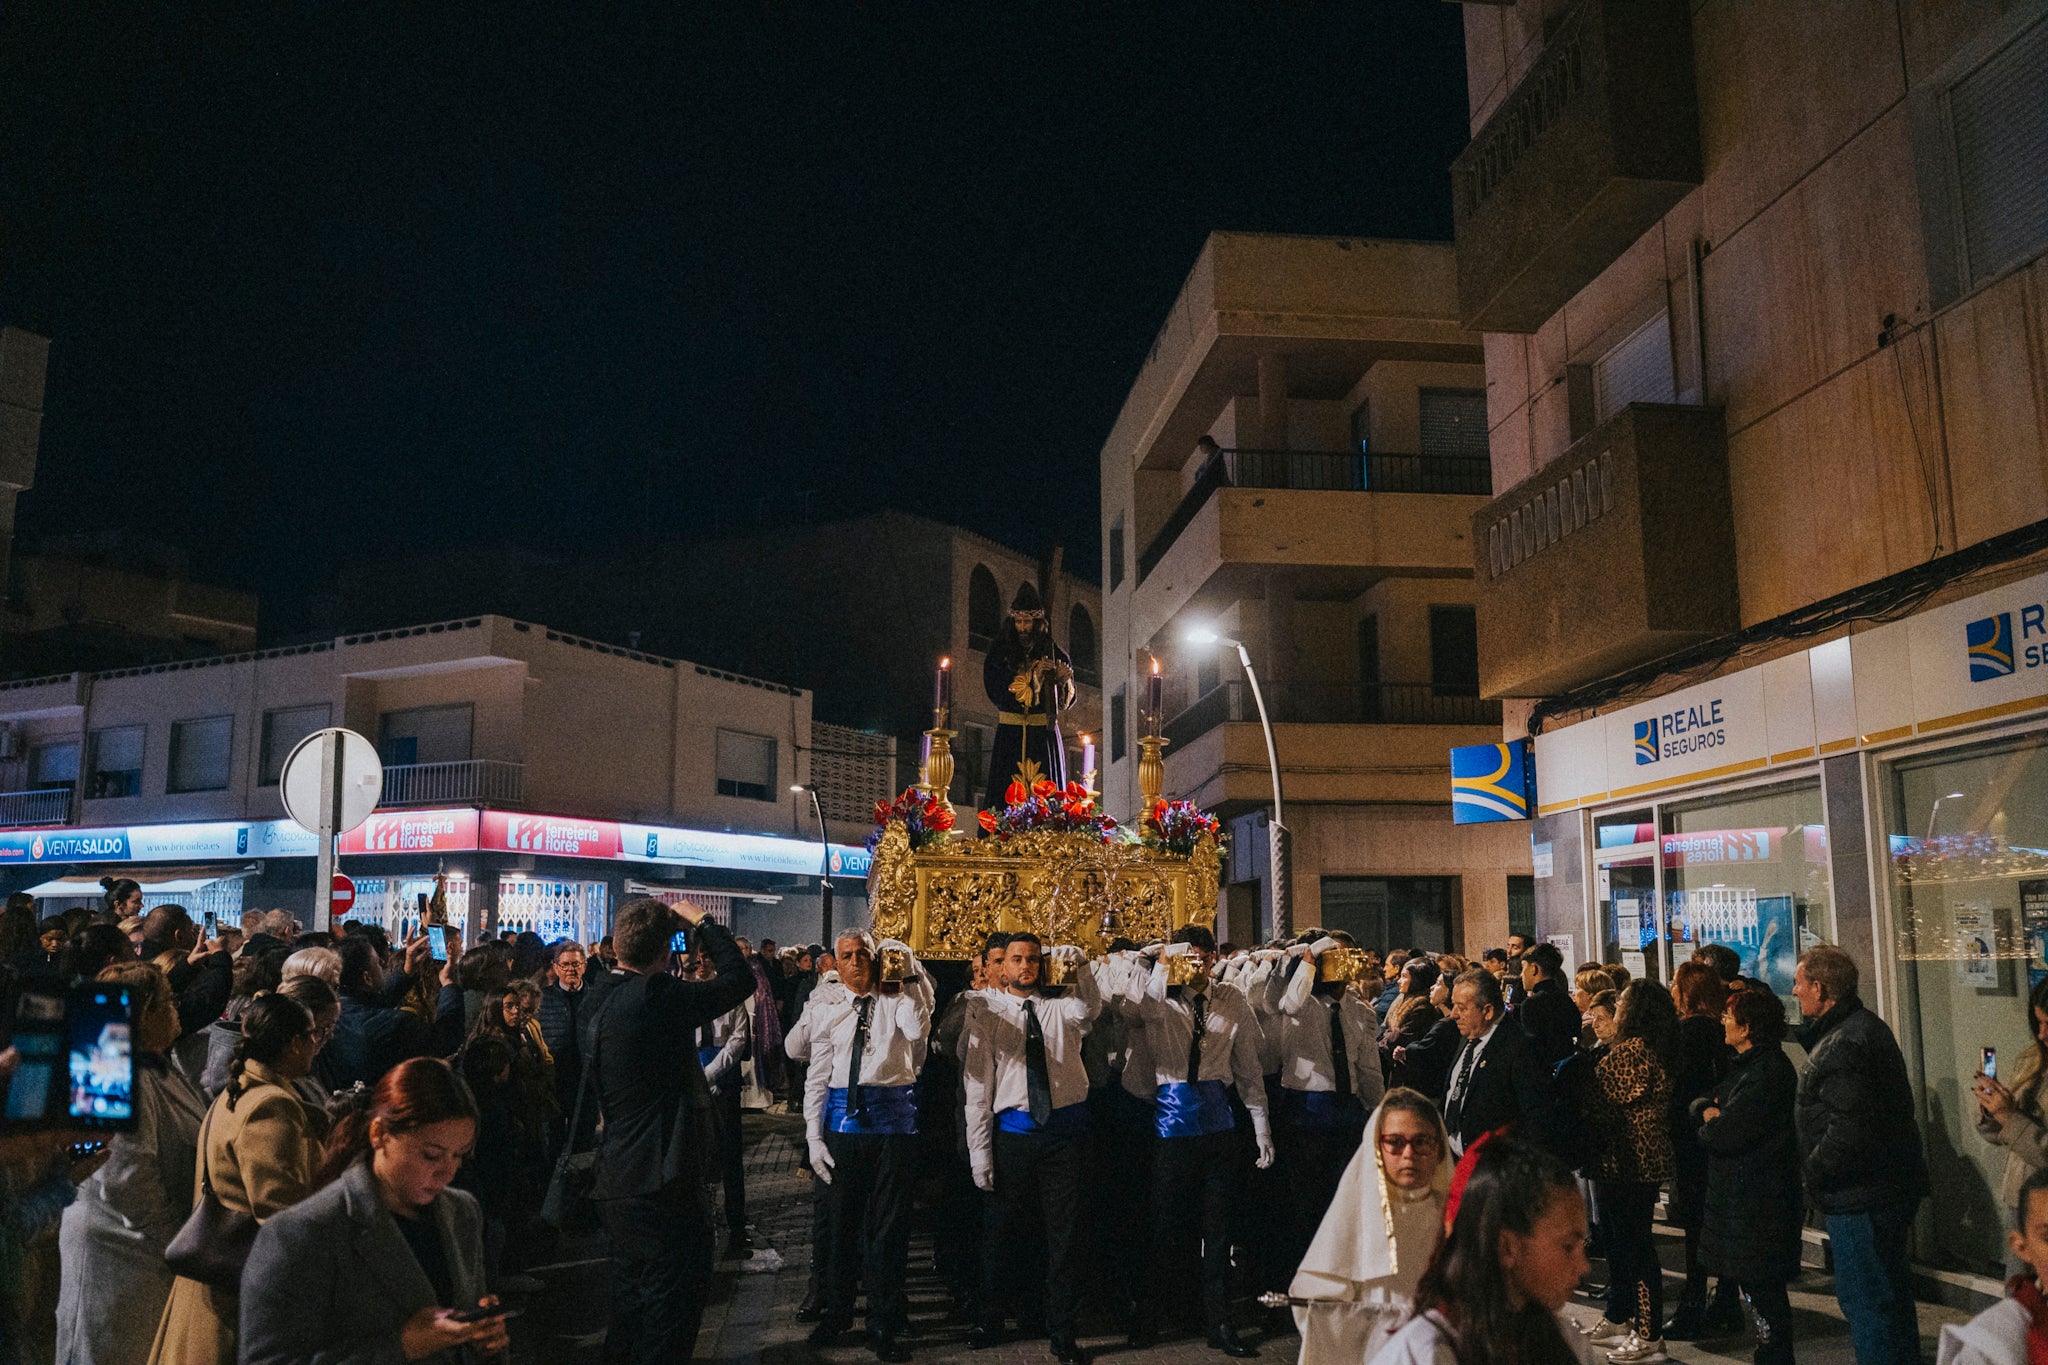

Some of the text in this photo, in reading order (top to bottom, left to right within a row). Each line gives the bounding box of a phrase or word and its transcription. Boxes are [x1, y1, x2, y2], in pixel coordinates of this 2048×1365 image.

[2021, 601, 2048, 640] R
[1661, 699, 1724, 738] REALE
[1664, 729, 1725, 758] SEGUROS
[400, 832, 434, 848] flores
[545, 824, 598, 842] ferretería
[46, 838, 123, 855] VENTASALDO
[146, 841, 221, 852] www.bricoidea.es
[545, 839, 579, 853] flores
[739, 853, 807, 866] www.bricoidea.es
[843, 856, 870, 871] VENT
